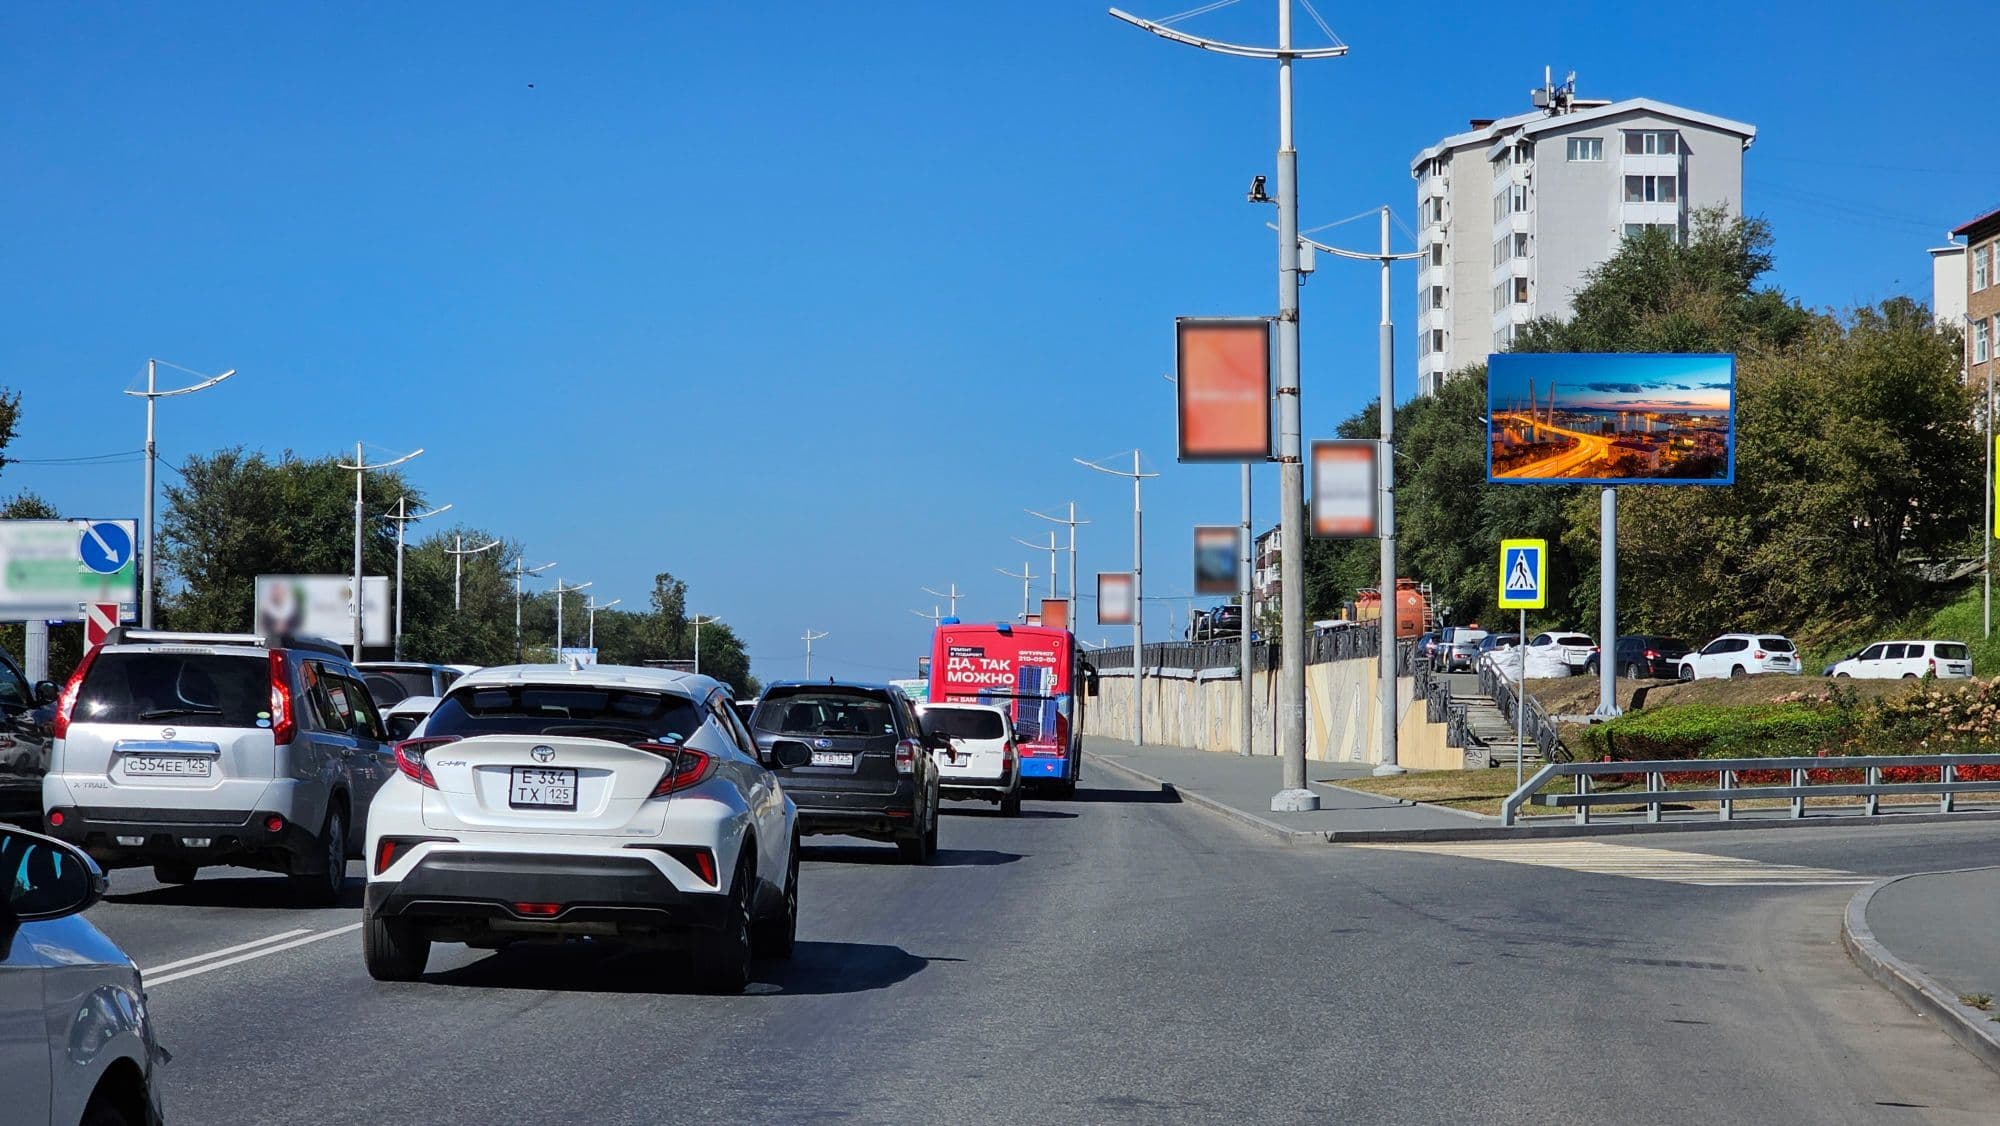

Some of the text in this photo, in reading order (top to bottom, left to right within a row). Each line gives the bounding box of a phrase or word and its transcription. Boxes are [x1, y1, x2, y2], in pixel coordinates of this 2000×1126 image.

[947, 658, 1011, 671] ДА, ТАК
[947, 671, 1015, 684] МОЖНО
[1048, 675, 1056, 684] 23
[185, 758, 205, 769] 125
[549, 789, 570, 799] 125
